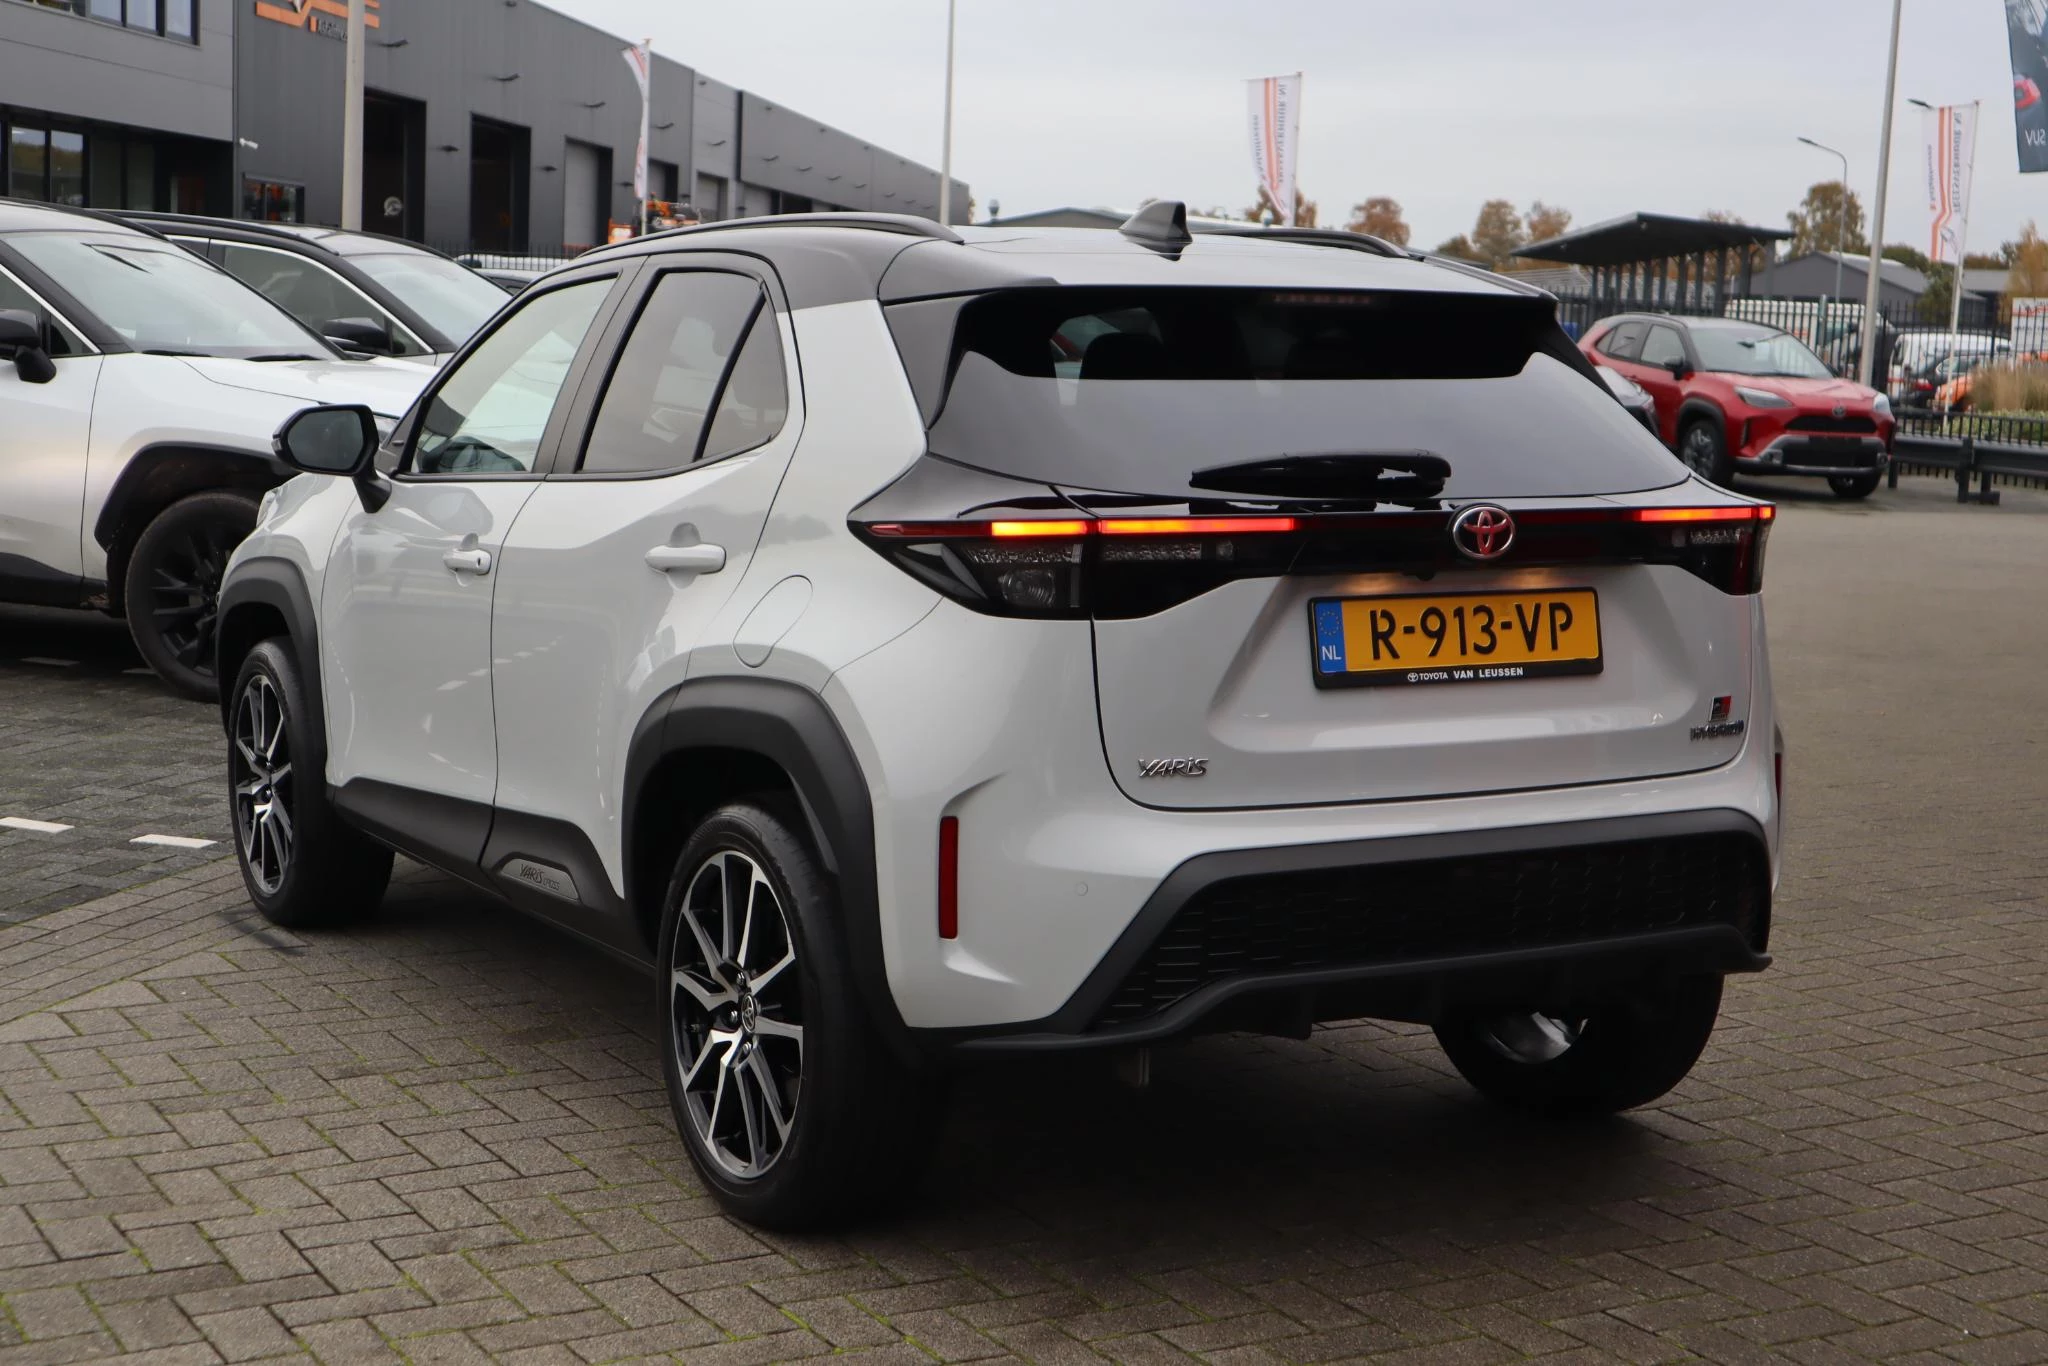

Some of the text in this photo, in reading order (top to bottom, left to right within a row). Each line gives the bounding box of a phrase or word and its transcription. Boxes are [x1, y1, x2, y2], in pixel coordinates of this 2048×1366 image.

[1369, 602, 1573, 660] R-913-VP
[1321, 645, 1341, 661] NL
[1419, 667, 1523, 681] TOYOTA VAN LEUSSEN
